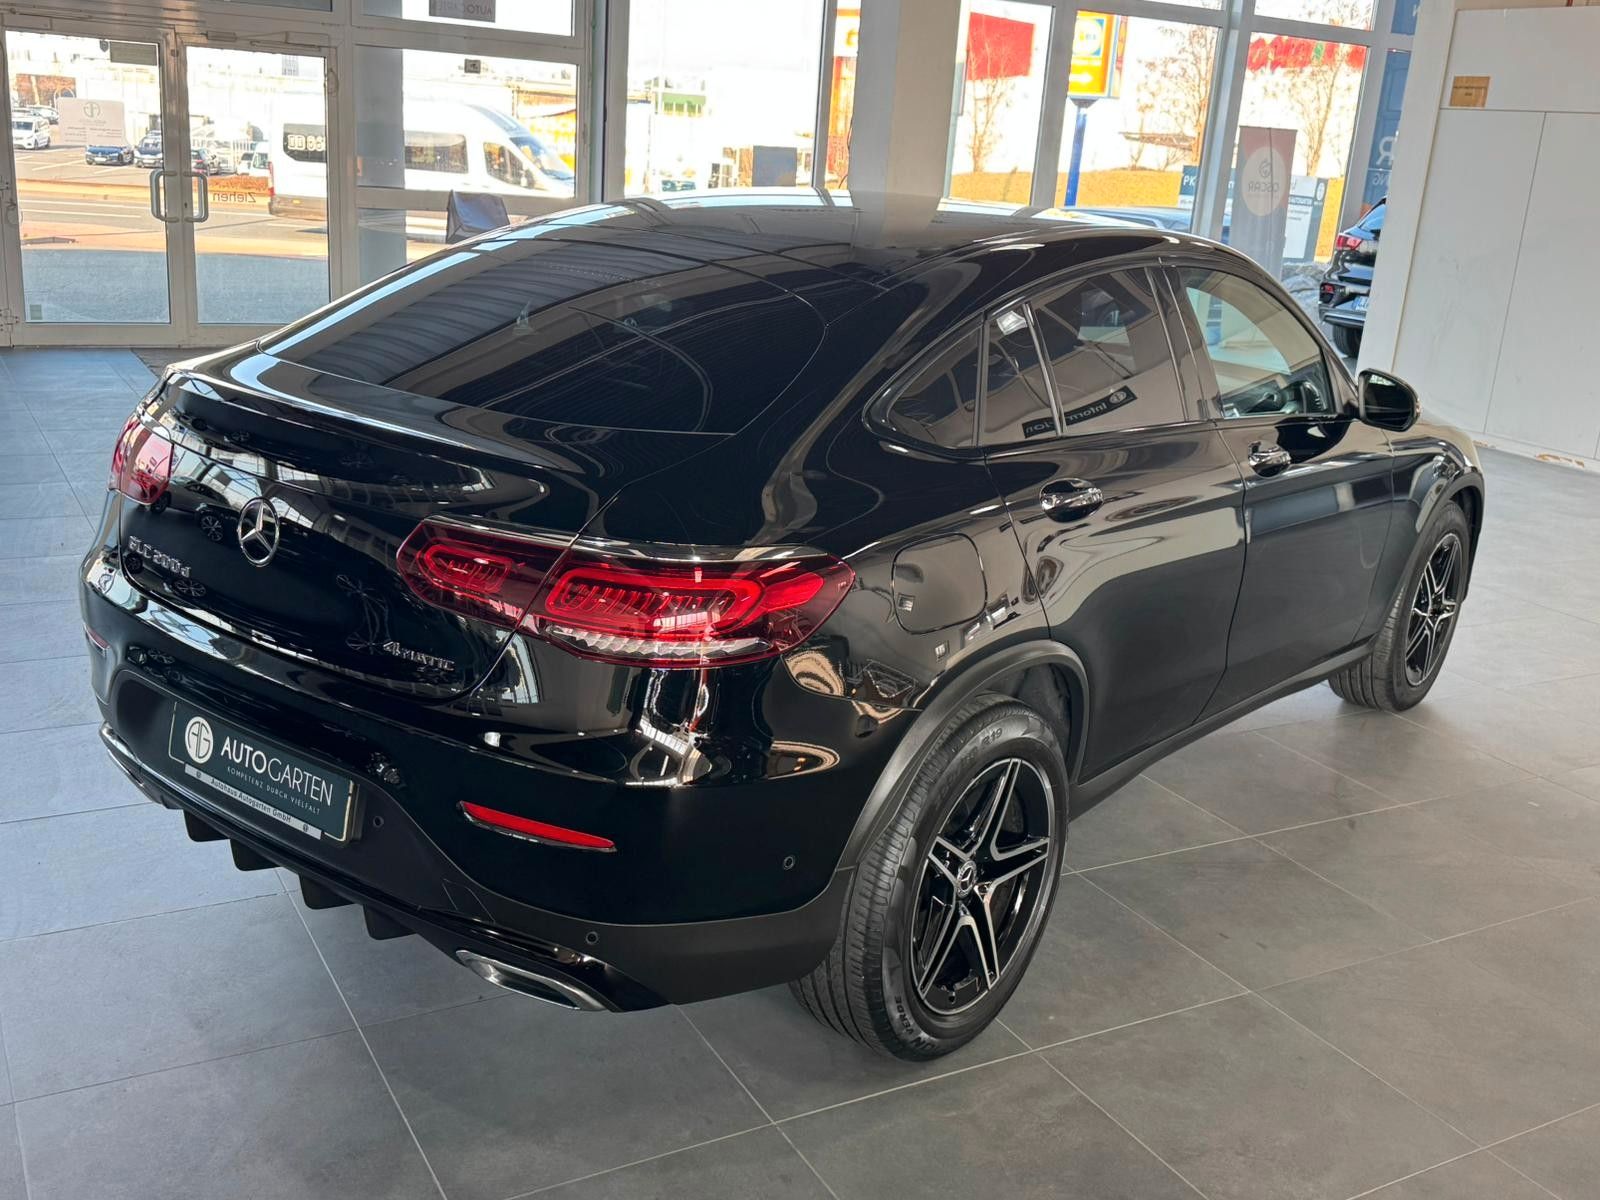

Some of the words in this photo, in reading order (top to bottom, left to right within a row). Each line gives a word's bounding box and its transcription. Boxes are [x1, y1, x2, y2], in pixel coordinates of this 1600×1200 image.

[220, 735, 334, 807] AUTOGARTEN
[227, 766, 264, 790] KOMPETENZ
[265, 784, 289, 800] DURCH
[290, 796, 321, 816] VIELFALT
[238, 791, 272, 814] Autogarten
[271, 808, 292, 824] GmbH
